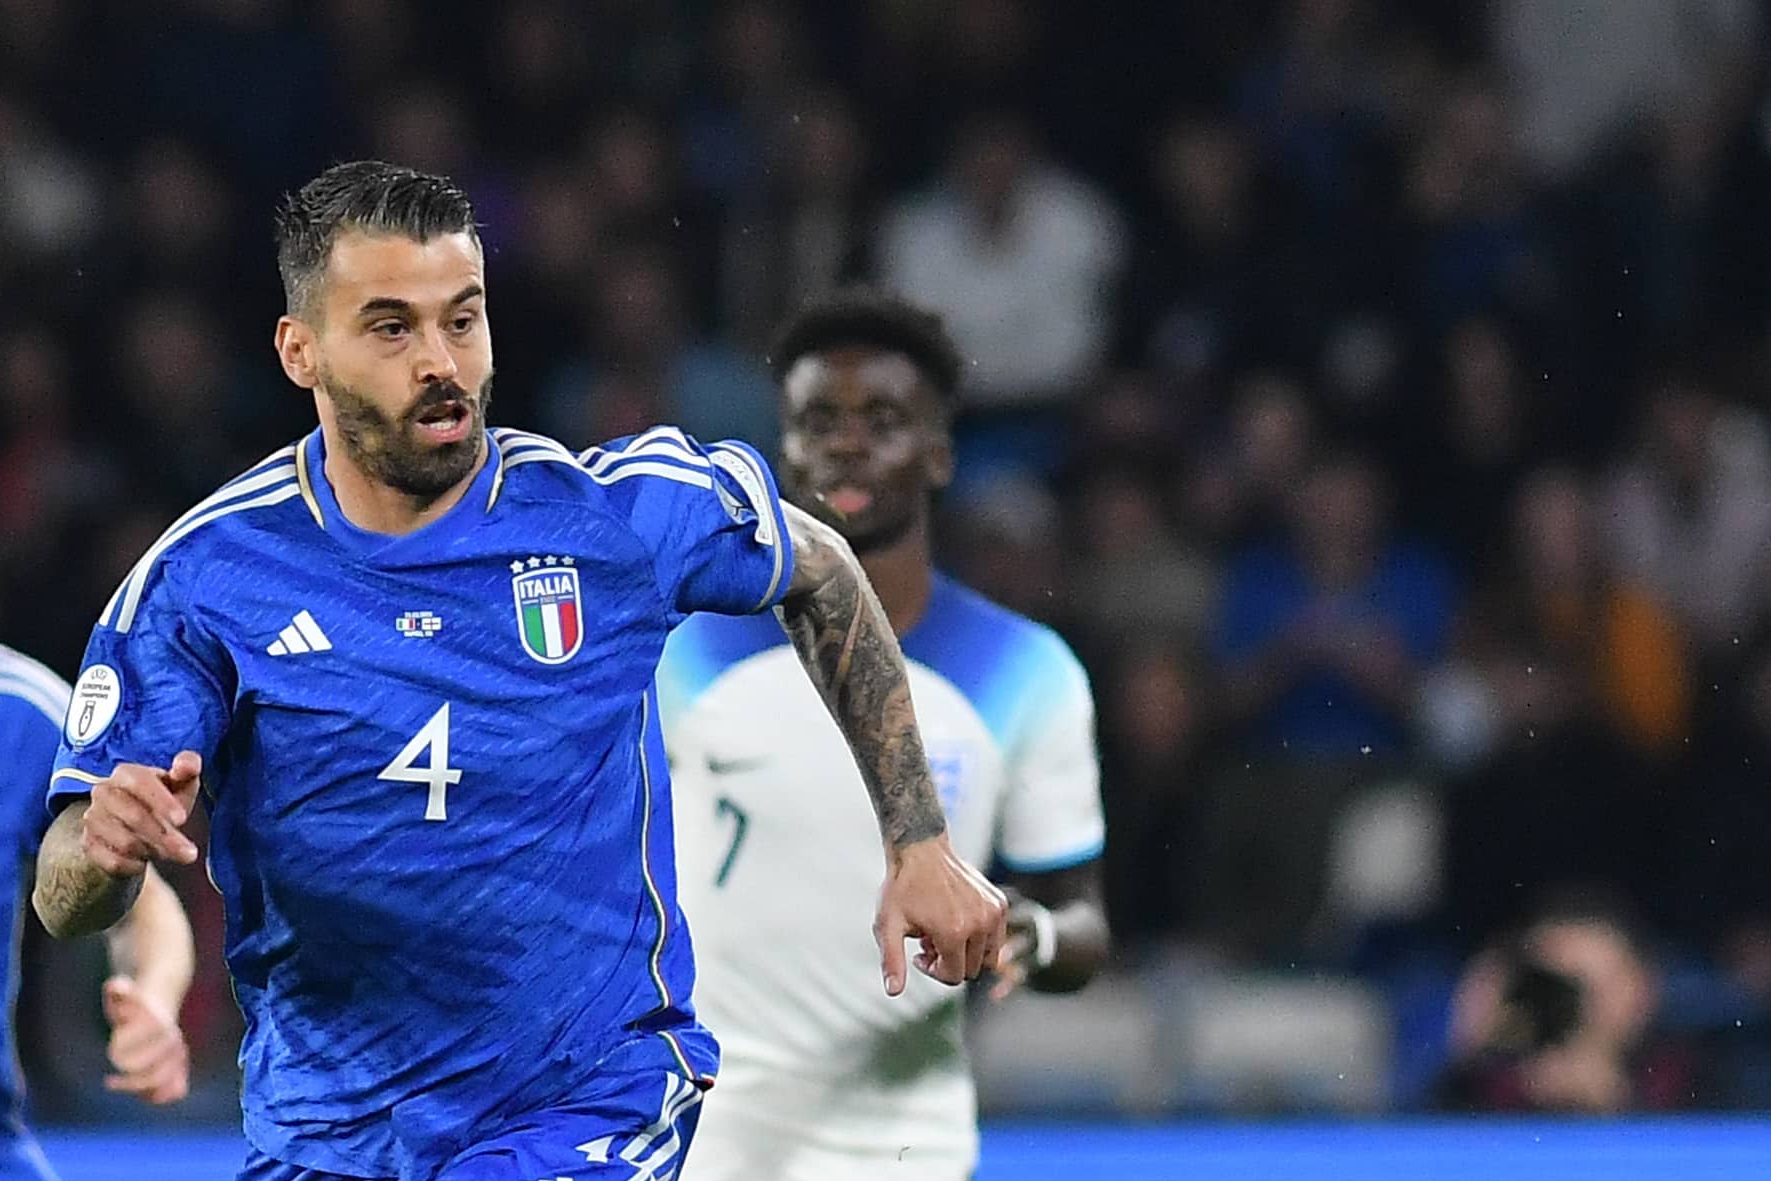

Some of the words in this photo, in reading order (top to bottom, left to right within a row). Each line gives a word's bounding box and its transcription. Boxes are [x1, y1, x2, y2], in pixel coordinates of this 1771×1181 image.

[519, 575, 574, 599] ITALIA
[377, 702, 461, 821] 4
[716, 798, 747, 887] 7
